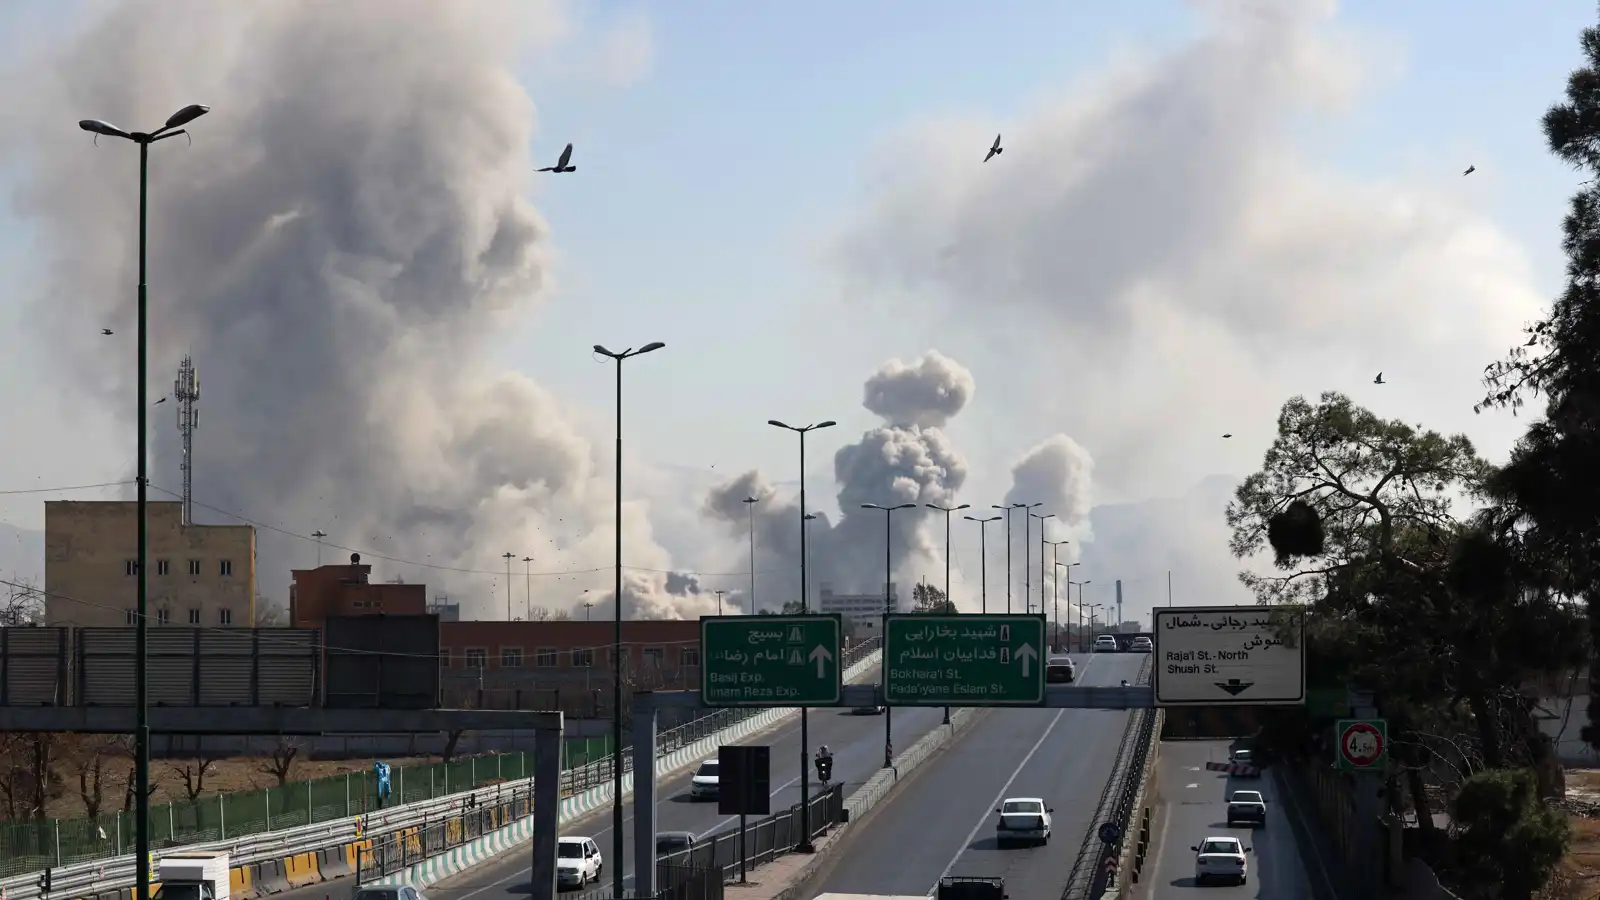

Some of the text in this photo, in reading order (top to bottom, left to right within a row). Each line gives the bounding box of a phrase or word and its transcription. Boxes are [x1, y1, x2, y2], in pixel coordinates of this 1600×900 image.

[1166, 614, 1202, 630] شمال
[748, 630, 783, 645] بسیج
[905, 623, 997, 642] شهید بخارایی
[753, 649, 784, 665] امام
[900, 646, 997, 664] فداییان اسلام
[1218, 650, 1249, 660] North
[945, 668, 962, 679] St.
[1167, 664, 1219, 674] Shush St.
[709, 672, 738, 685] Basij
[709, 686, 801, 698] Imam Reza Exp.
[953, 683, 987, 694] Eslam
[990, 683, 1007, 694] St.
